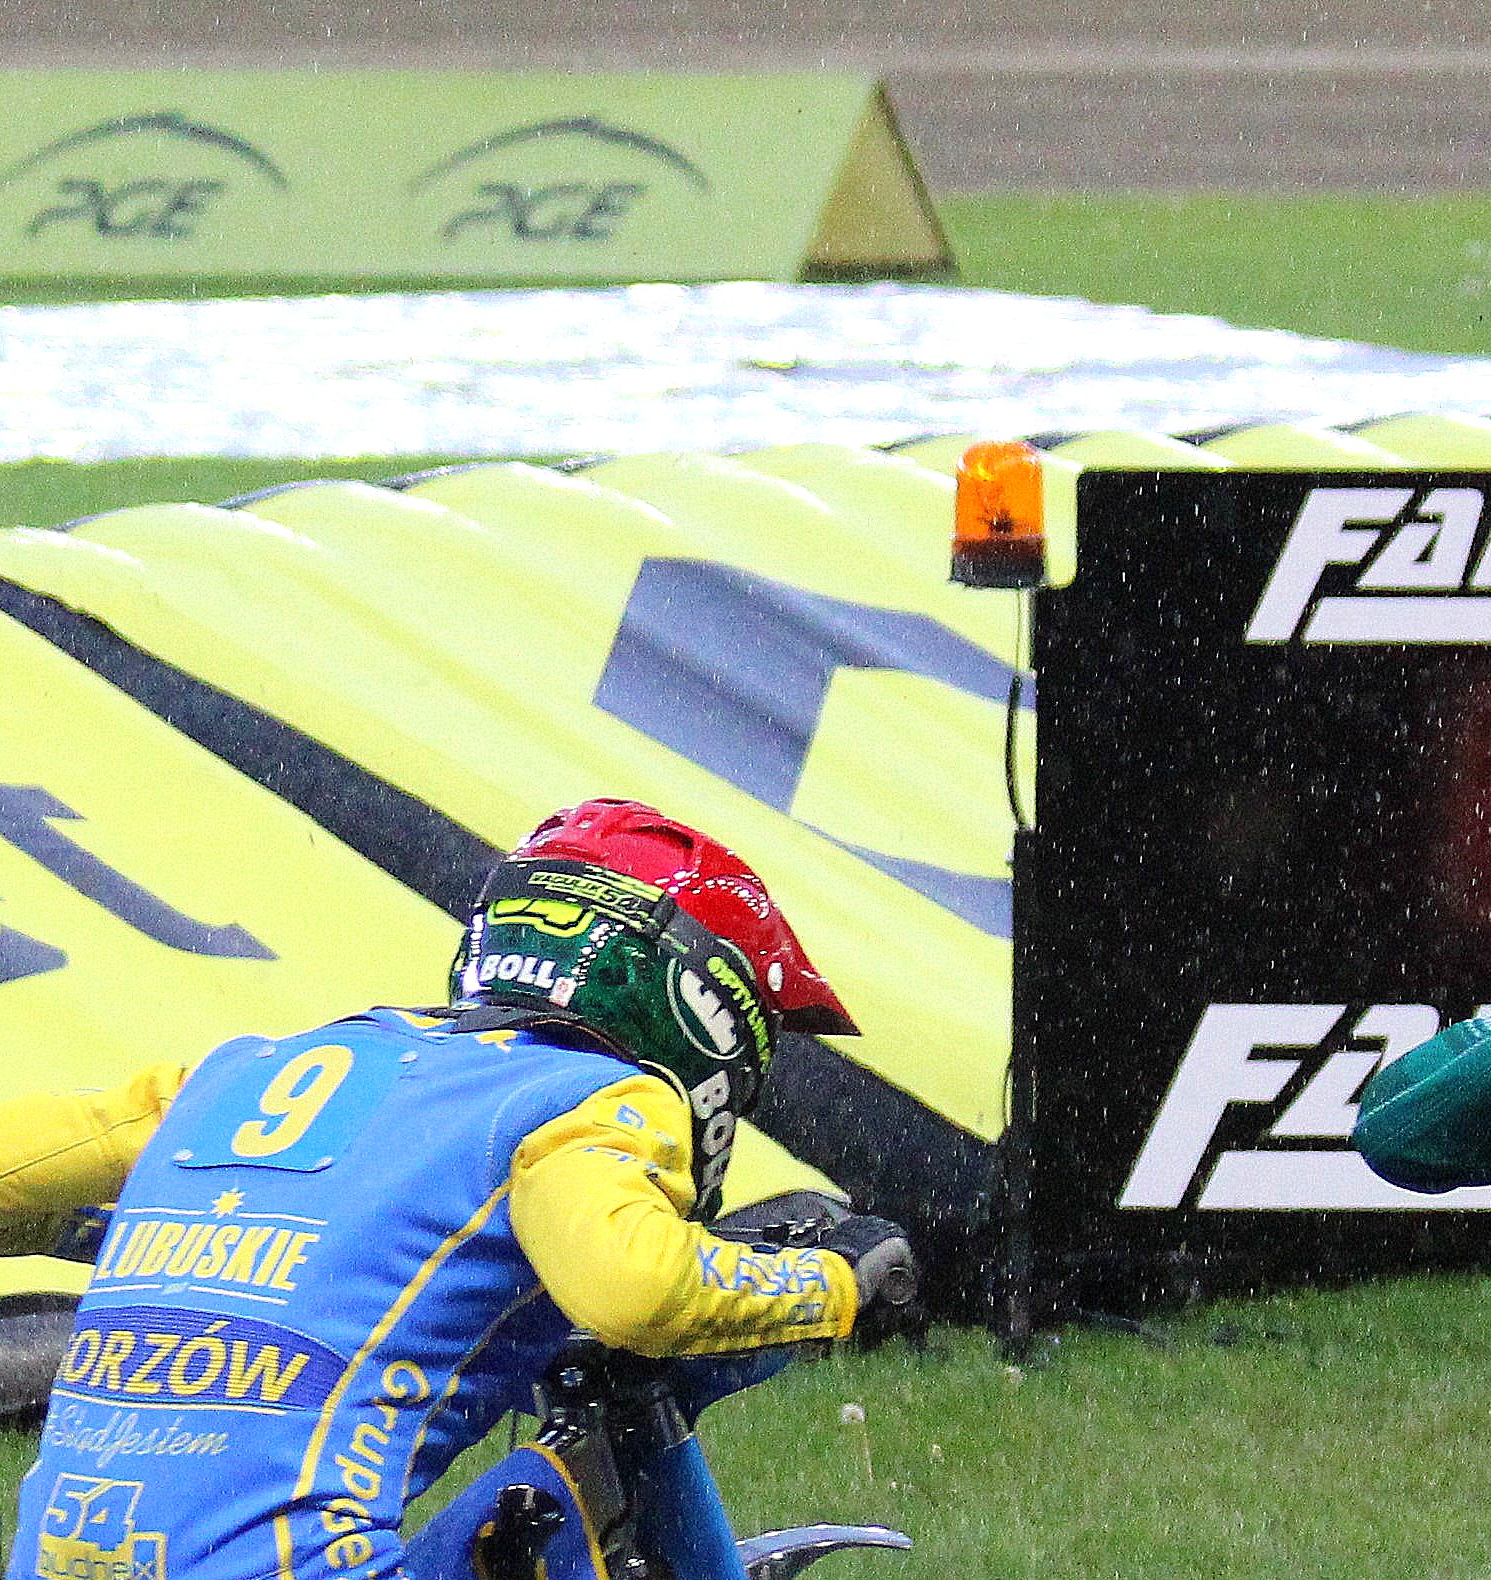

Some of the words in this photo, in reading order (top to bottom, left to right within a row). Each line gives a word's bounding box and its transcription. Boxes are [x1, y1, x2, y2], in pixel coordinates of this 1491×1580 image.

[22, 177, 224, 241] PGE
[444, 181, 646, 243] PGE
[479, 953, 557, 989] BOLL
[231, 1044, 355, 1158] 9
[96, 1221, 321, 1291] LUBUSKIE
[60, 1321, 310, 1402] ORZÓW
